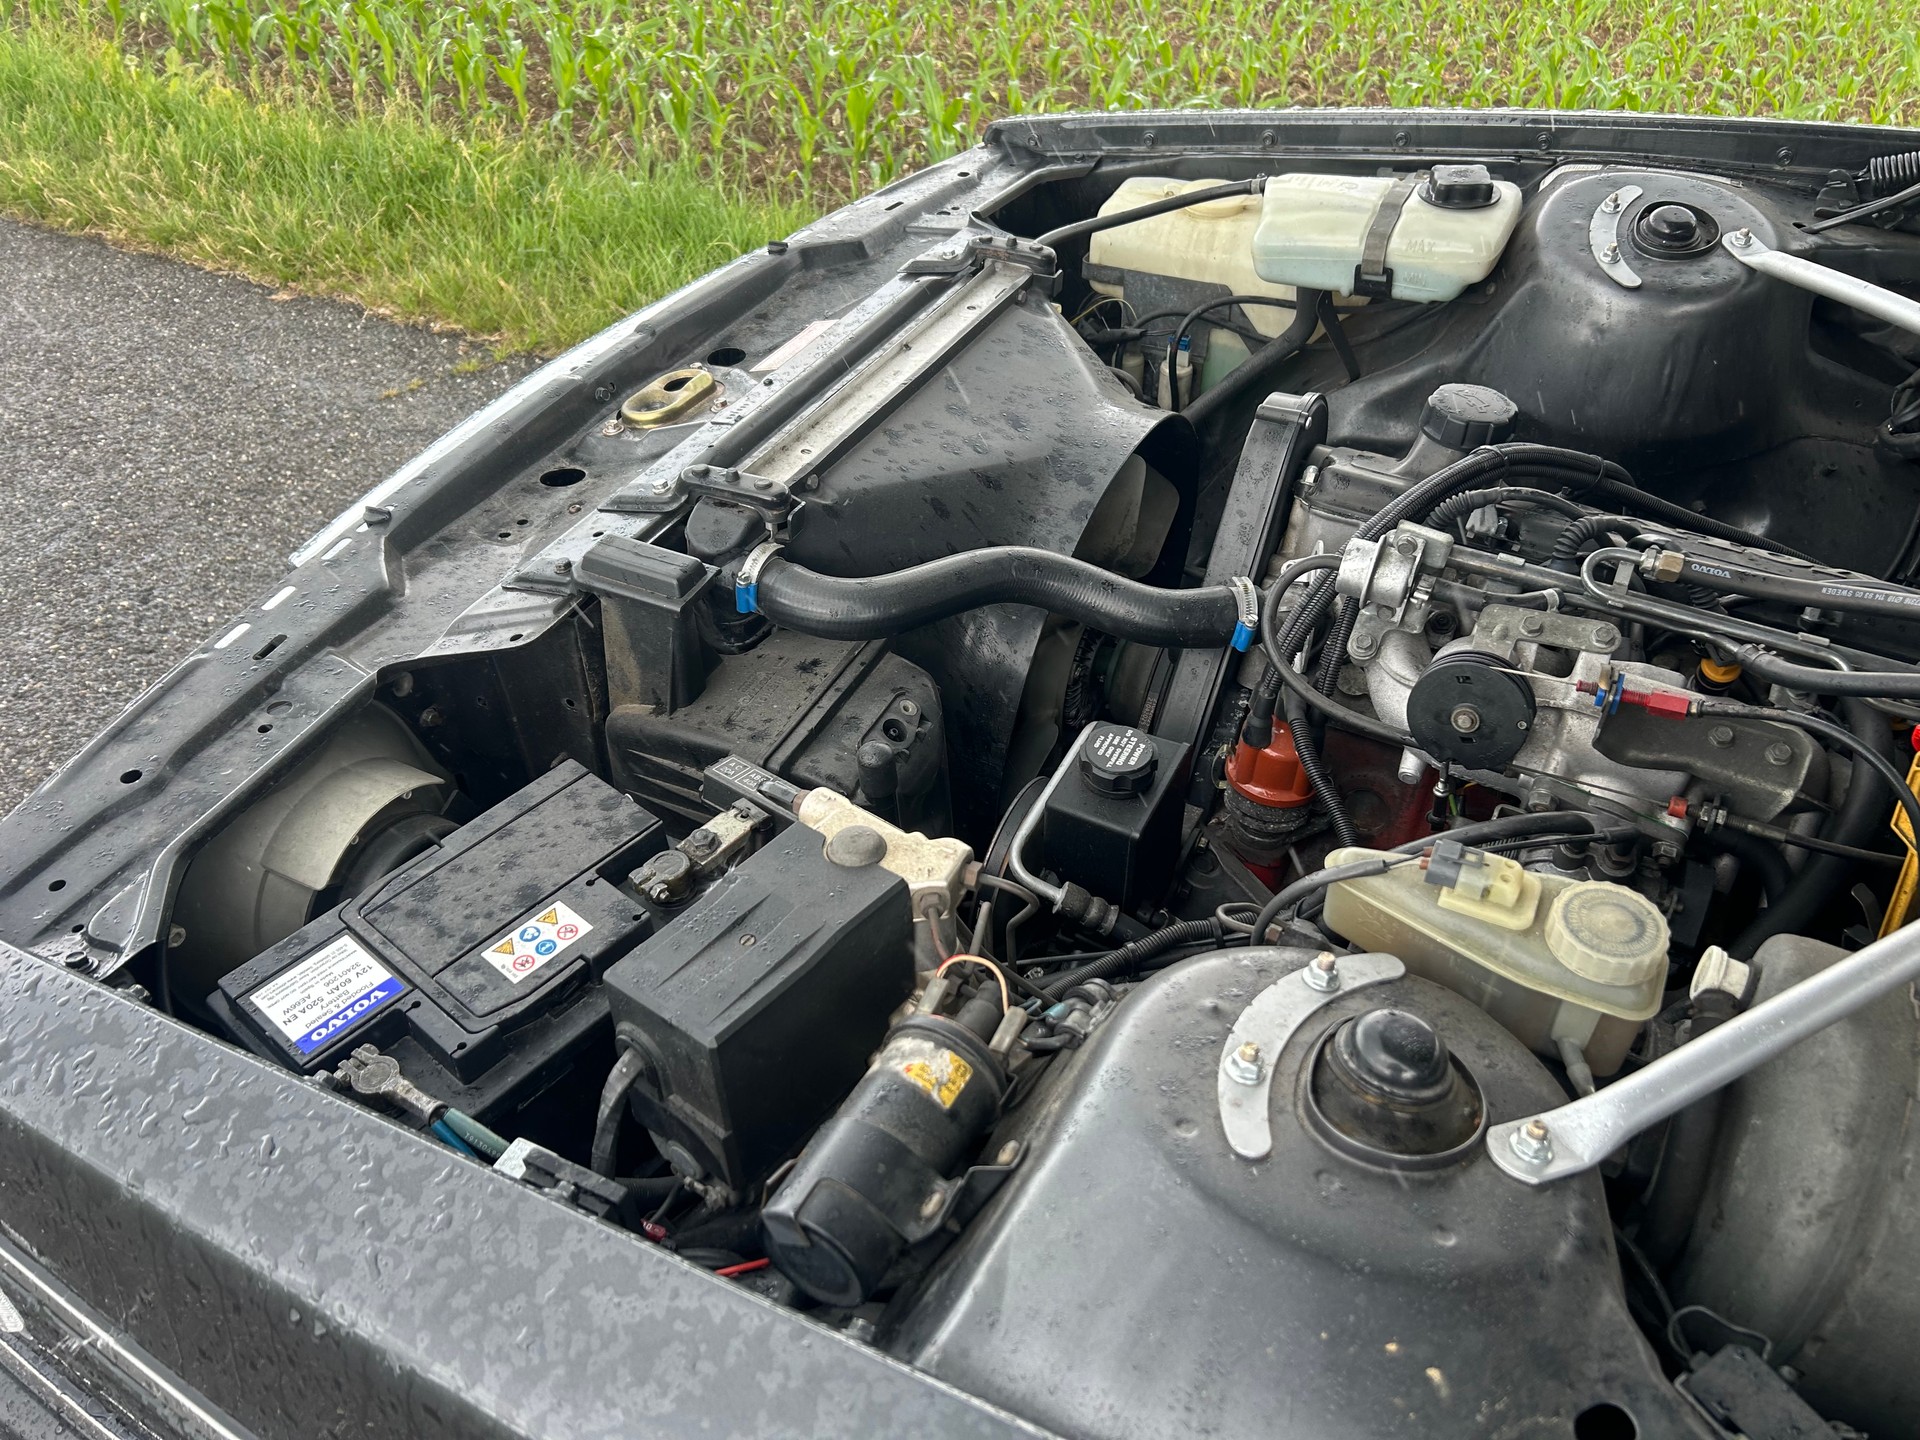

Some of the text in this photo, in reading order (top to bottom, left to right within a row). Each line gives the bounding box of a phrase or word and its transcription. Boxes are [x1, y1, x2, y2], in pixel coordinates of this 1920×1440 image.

[1691, 563, 1732, 579] VOLVO
[1821, 586, 1853, 597] SWEDEN
[1125, 729, 1134, 737] DO
[1115, 736, 1138, 766] STEERING
[1119, 737, 1129, 748] NOT
[1127, 743, 1146, 766] POWER
[356, 965, 372, 978] 12V
[320, 989, 349, 1010] Battery
[341, 982, 374, 1004] Flooded
[298, 996, 324, 1014] 520A
[283, 1014, 298, 1026] EN
[305, 1008, 333, 1029] Sealed
[311, 990, 388, 1041] VOLVO
